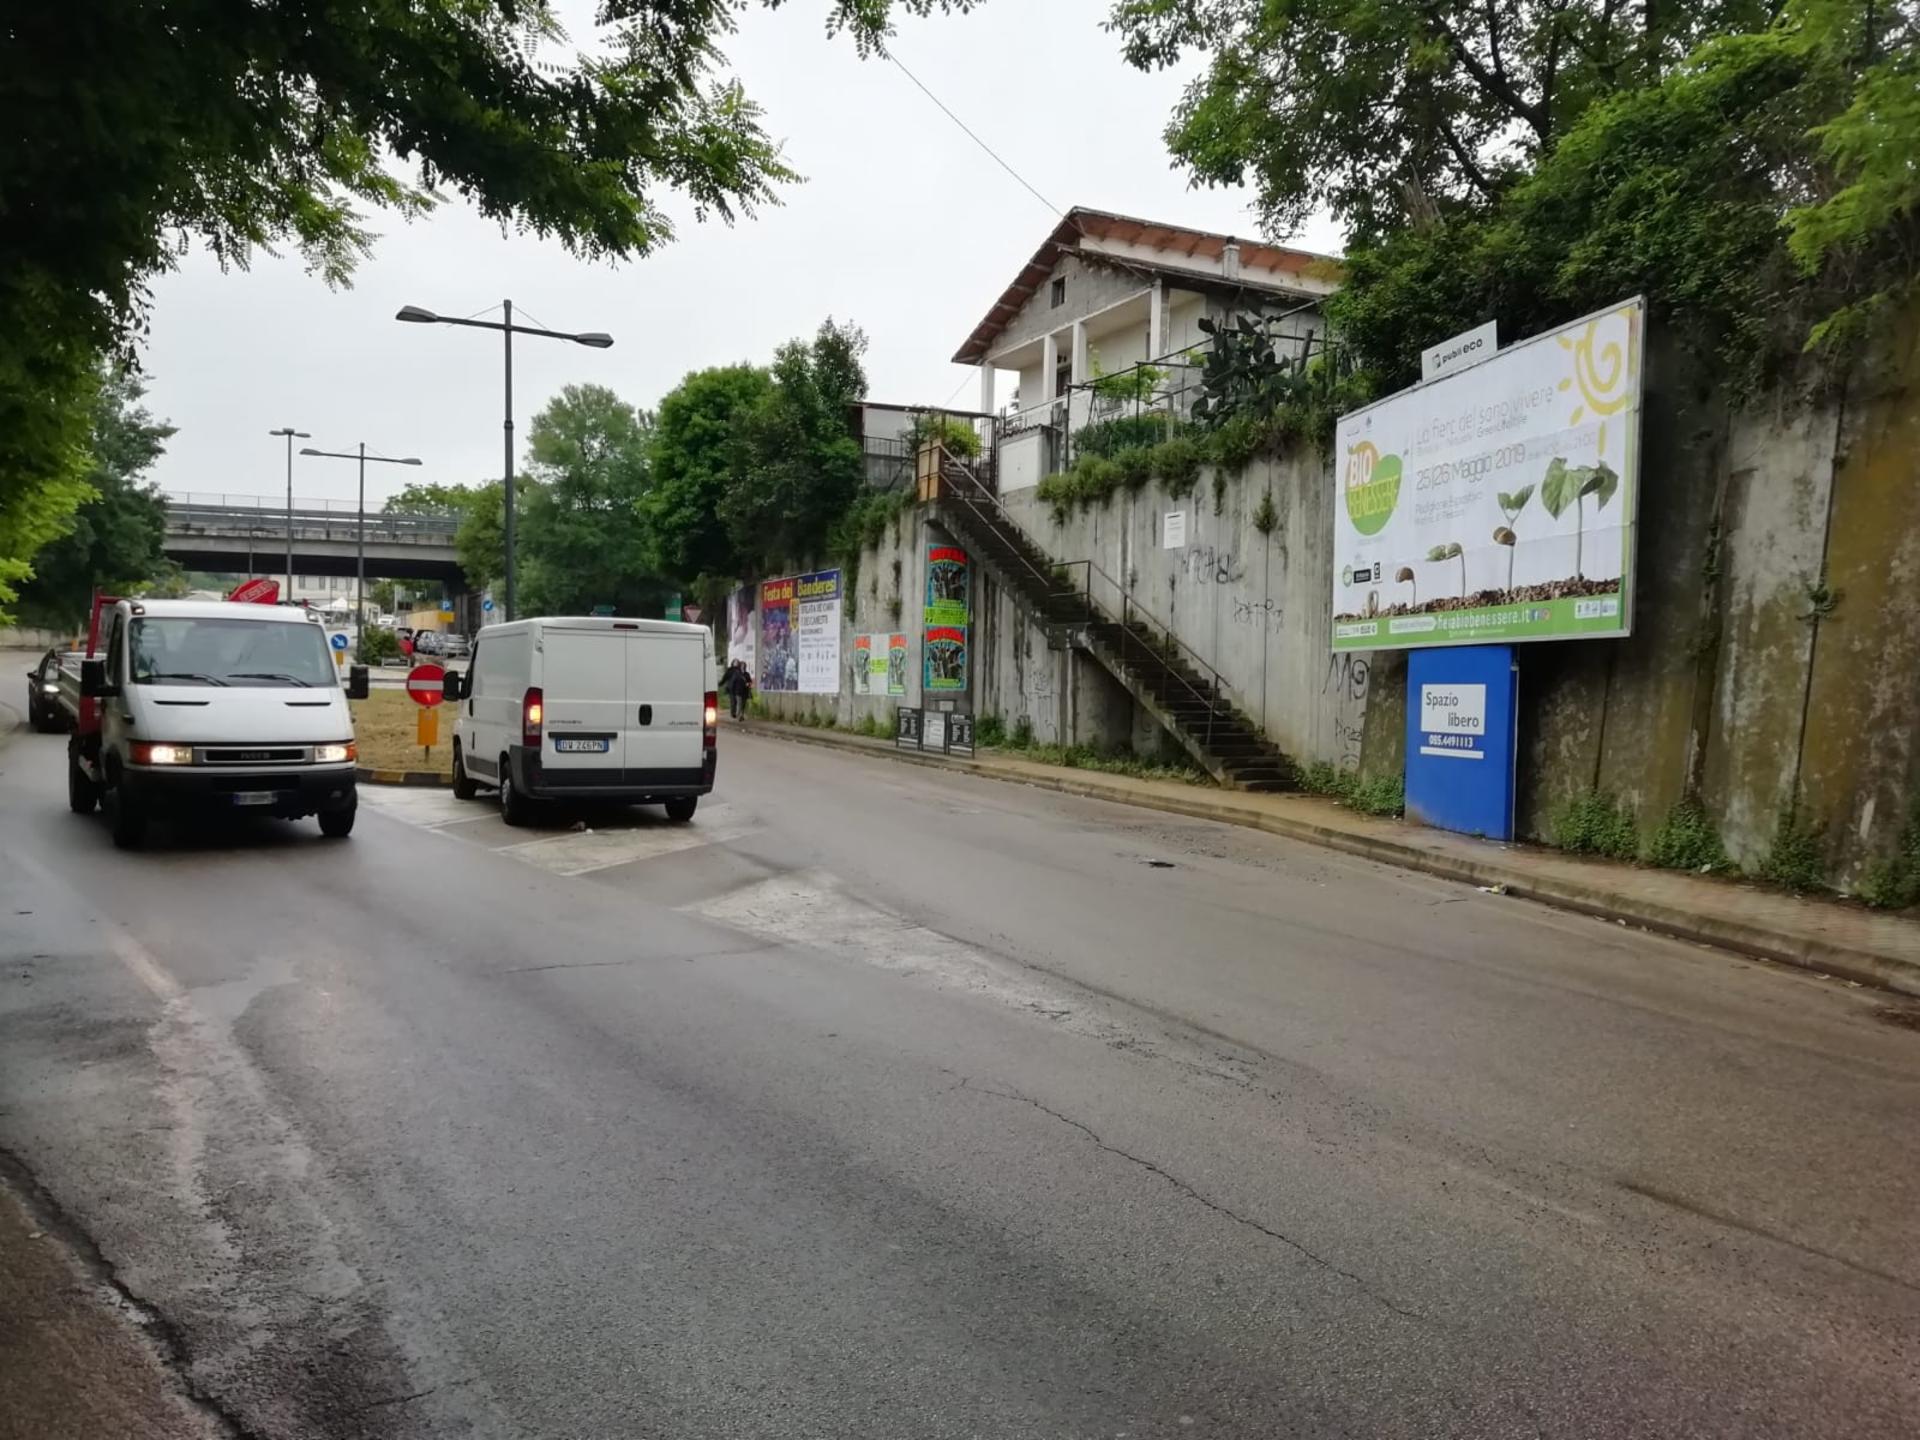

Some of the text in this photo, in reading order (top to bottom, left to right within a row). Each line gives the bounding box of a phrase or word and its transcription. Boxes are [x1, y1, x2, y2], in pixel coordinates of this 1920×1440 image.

[1458, 404, 1476, 431] del
[1513, 386, 1554, 411] vivere
[1349, 449, 1372, 487] BIO
[1452, 453, 1492, 484] Maggio
[1496, 443, 1527, 470] 2019
[1348, 475, 1400, 519] BENESSERE
[763, 584, 780, 602] Festa
[797, 574, 837, 597] Banderesi
[1425, 691, 1459, 711] Spazio
[1447, 712, 1480, 728] libero
